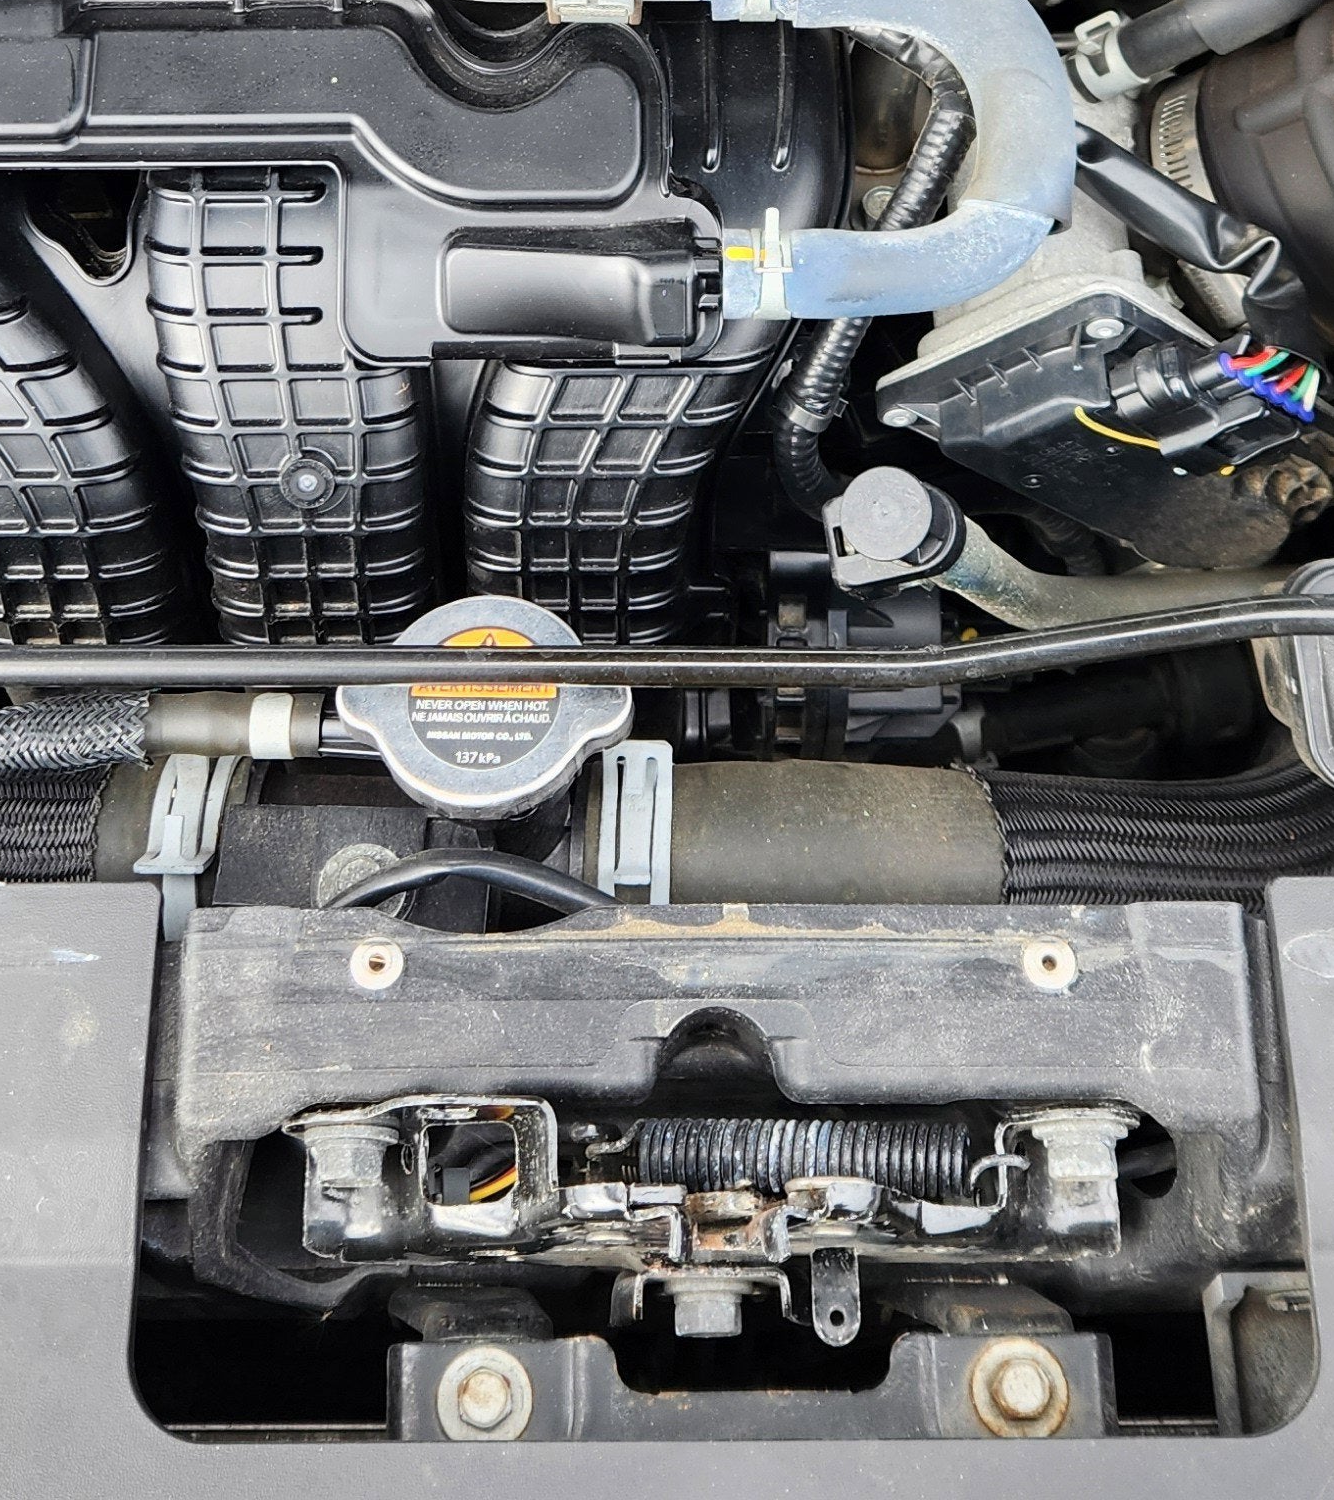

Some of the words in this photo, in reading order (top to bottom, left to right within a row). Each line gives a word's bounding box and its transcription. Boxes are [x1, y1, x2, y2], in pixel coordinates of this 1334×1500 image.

[416, 699, 453, 710] NEVER
[454, 700, 486, 710] OPEN
[487, 700, 522, 711] WHEN
[524, 701, 550, 711] HOT.
[411, 712, 426, 721] NE
[426, 712, 463, 722] JAMAIS
[463, 712, 502, 723] OUVRIR
[512, 713, 551, 723] CHAUD.
[426, 731, 460, 740] NISSAN
[461, 731, 495, 740] MOTOR
[455, 751, 479, 764] 137
[479, 751, 501, 764] kPa
